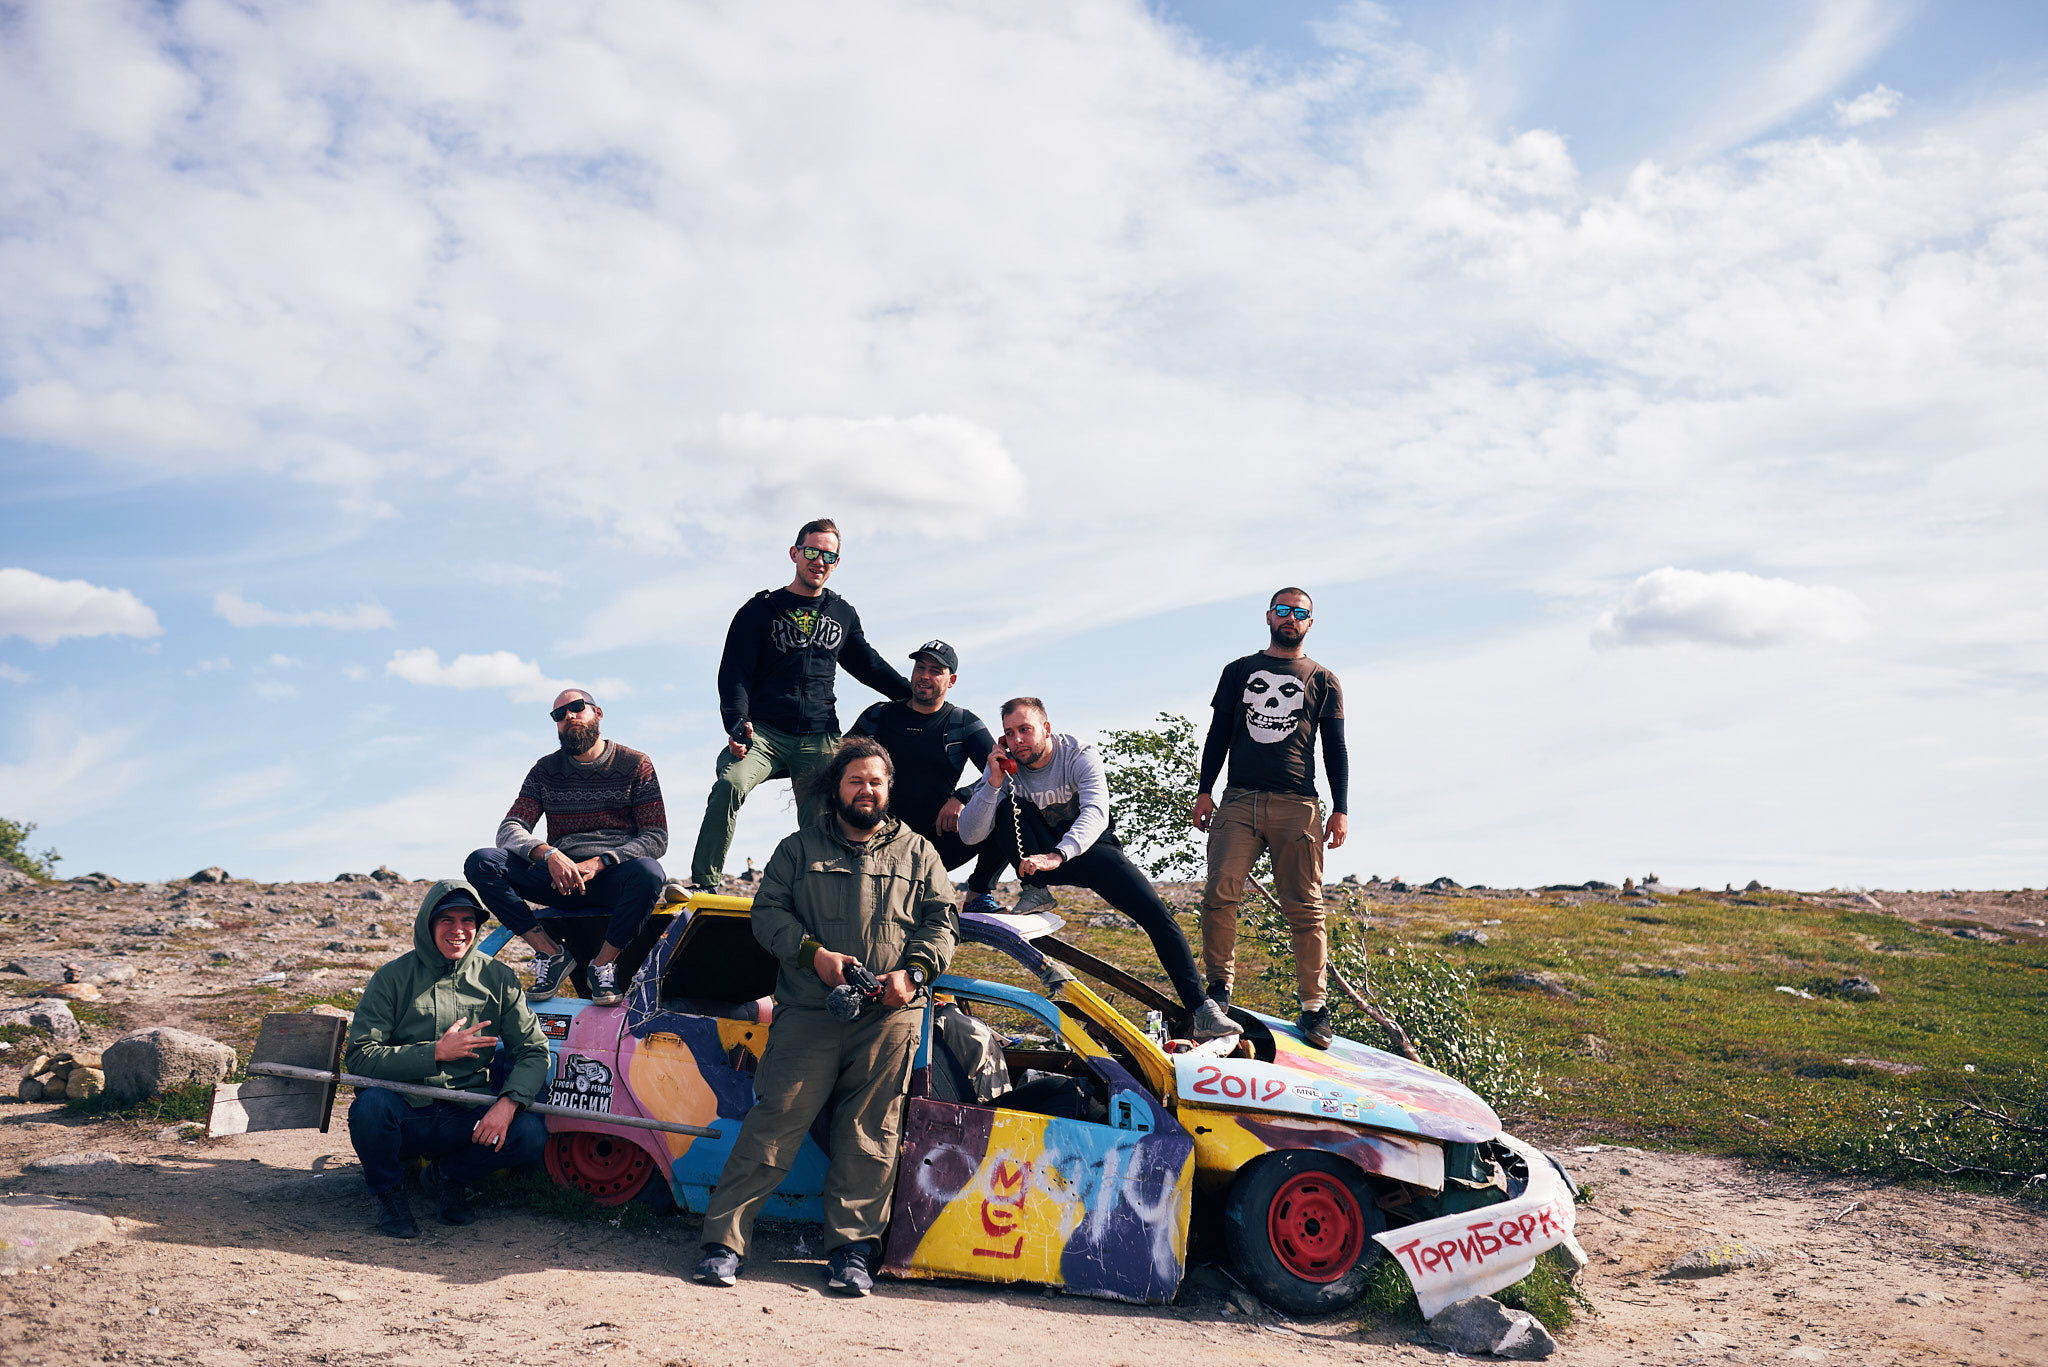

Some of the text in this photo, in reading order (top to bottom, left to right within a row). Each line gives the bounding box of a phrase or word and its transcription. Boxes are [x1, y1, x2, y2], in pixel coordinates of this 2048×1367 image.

[590, 1083, 612, 1095] РЕЙДЫ
[1193, 1066, 1287, 1102] 2019
[552, 1091, 610, 1113] РОССИИ
